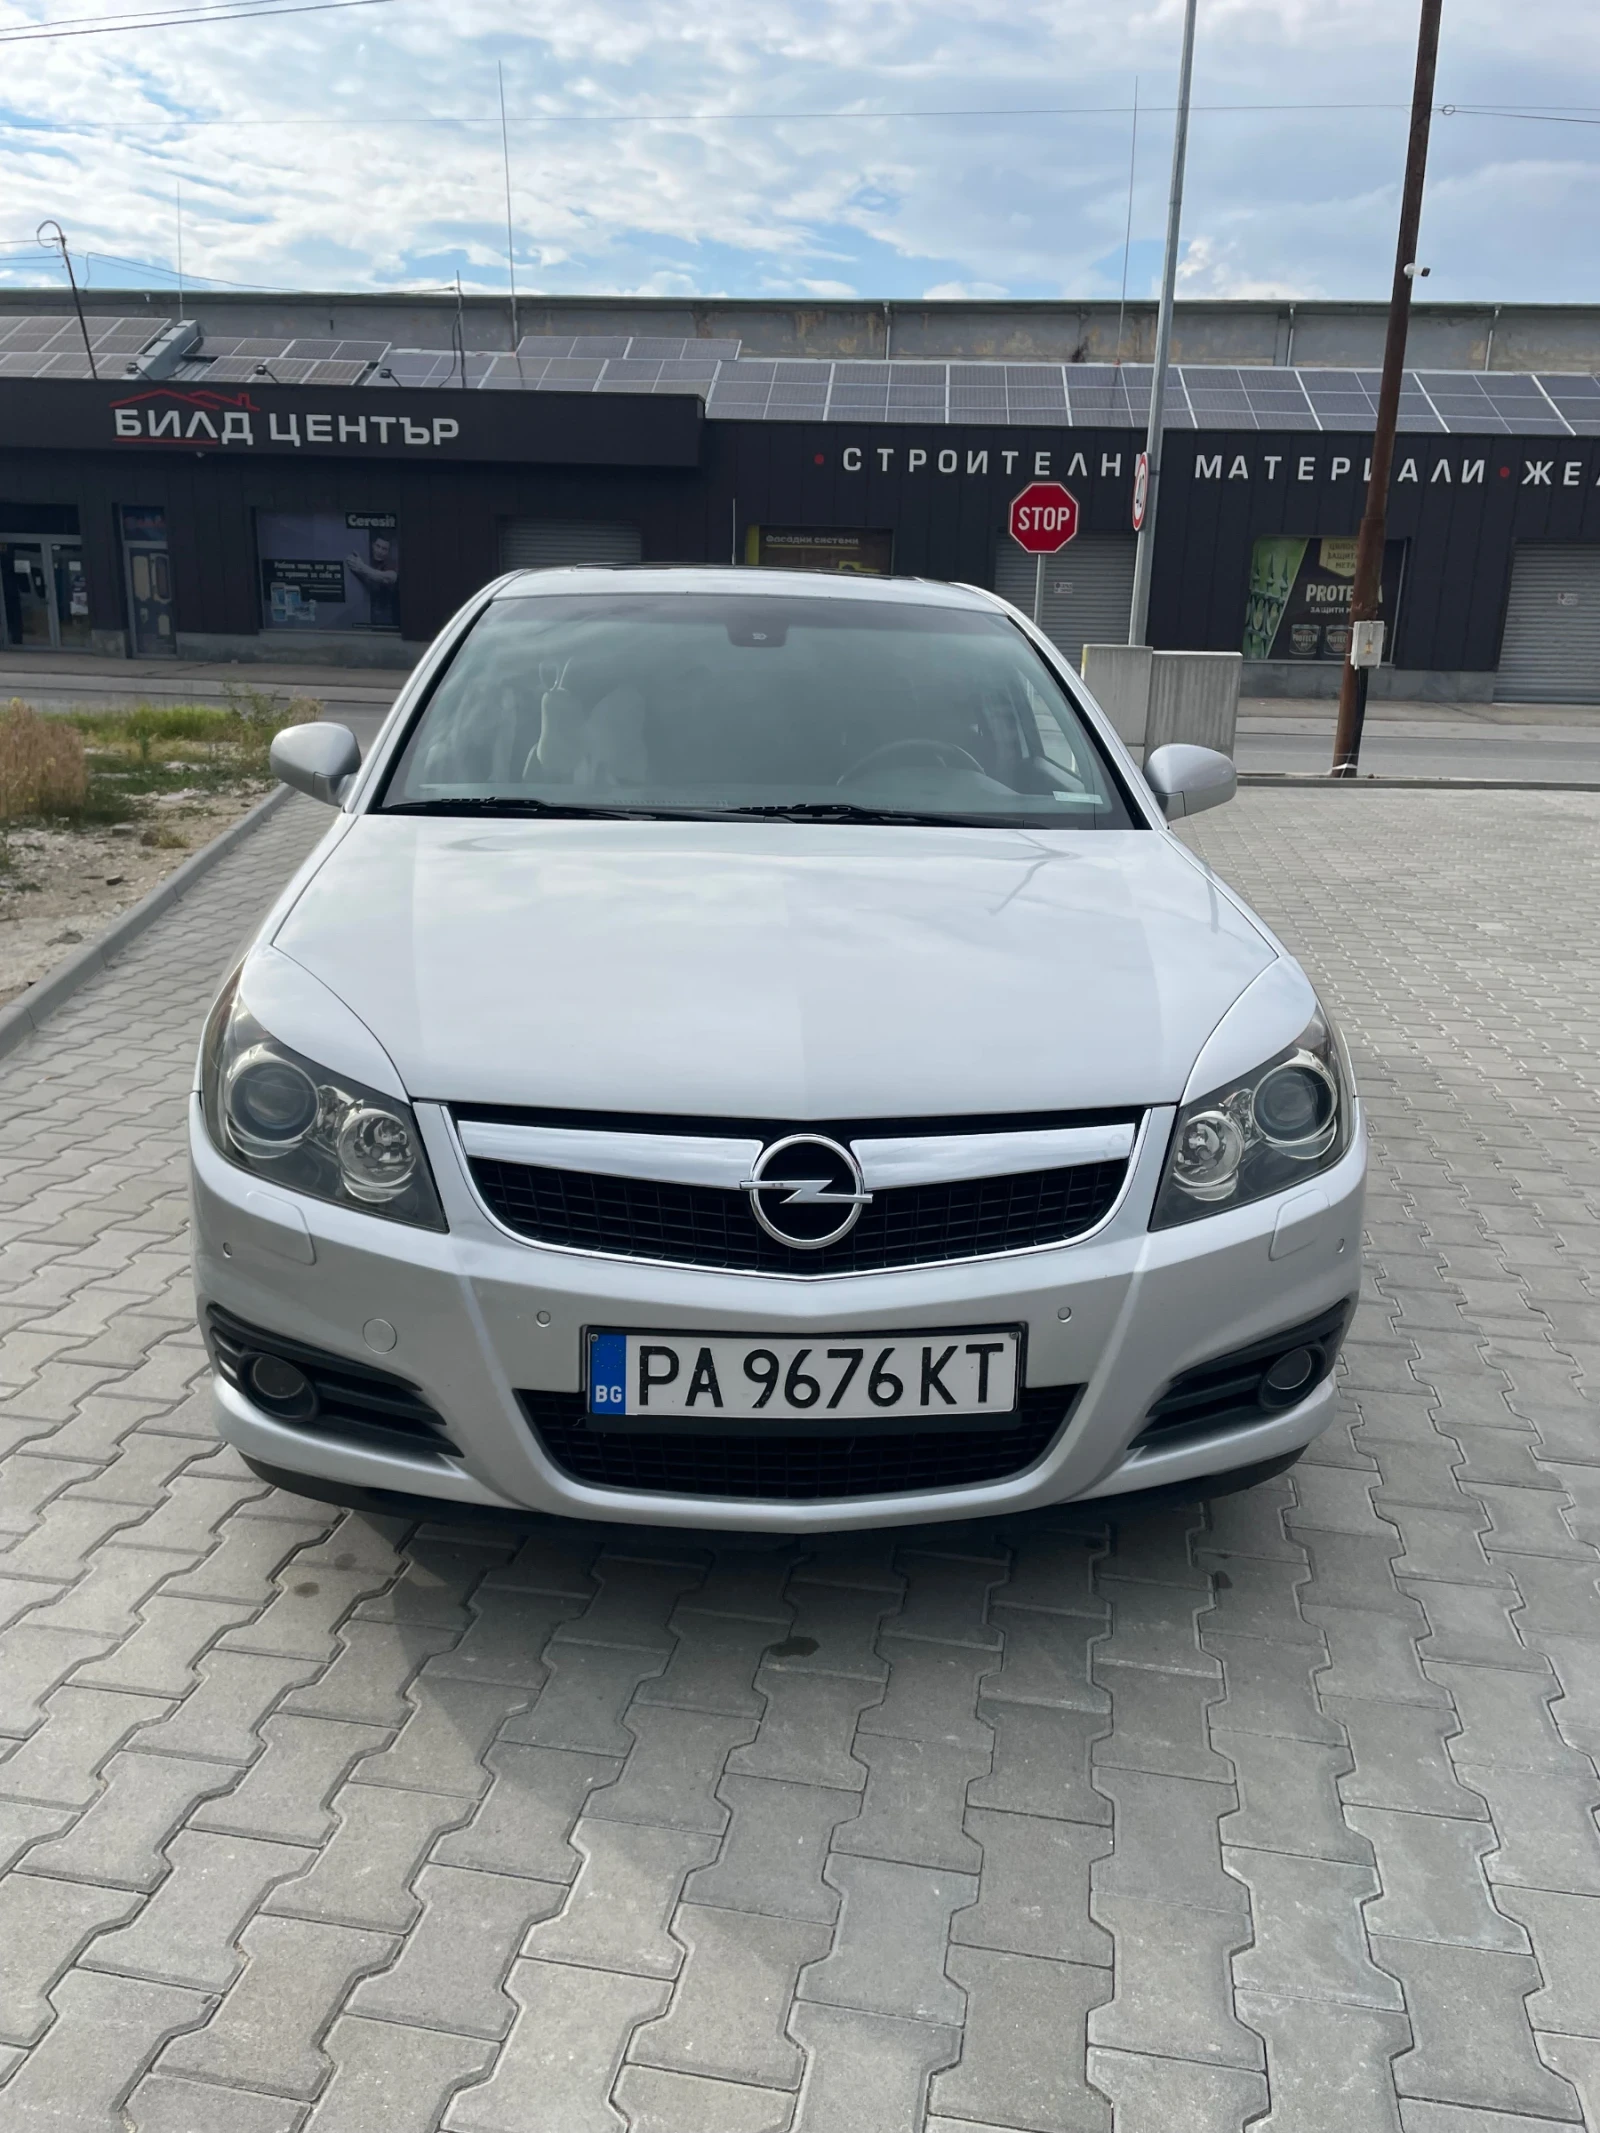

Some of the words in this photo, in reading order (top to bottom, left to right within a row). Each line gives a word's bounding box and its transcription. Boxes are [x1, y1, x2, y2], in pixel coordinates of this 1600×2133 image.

[115, 408, 254, 446] БИЛД
[269, 413, 459, 447] ЦЕНТЪР
[842, 447, 1142, 477] СТРОИТЕЛН
[1521, 460, 1600, 486] ЖЕ
[347, 514, 396, 528] Ceresit
[1017, 506, 1070, 532] STOP
[765, 534, 813, 545] Фасадни
[814, 536, 859, 546] системи
[1328, 552, 1357, 560] ЗАЩИТ
[595, 1385, 623, 1404] BG
